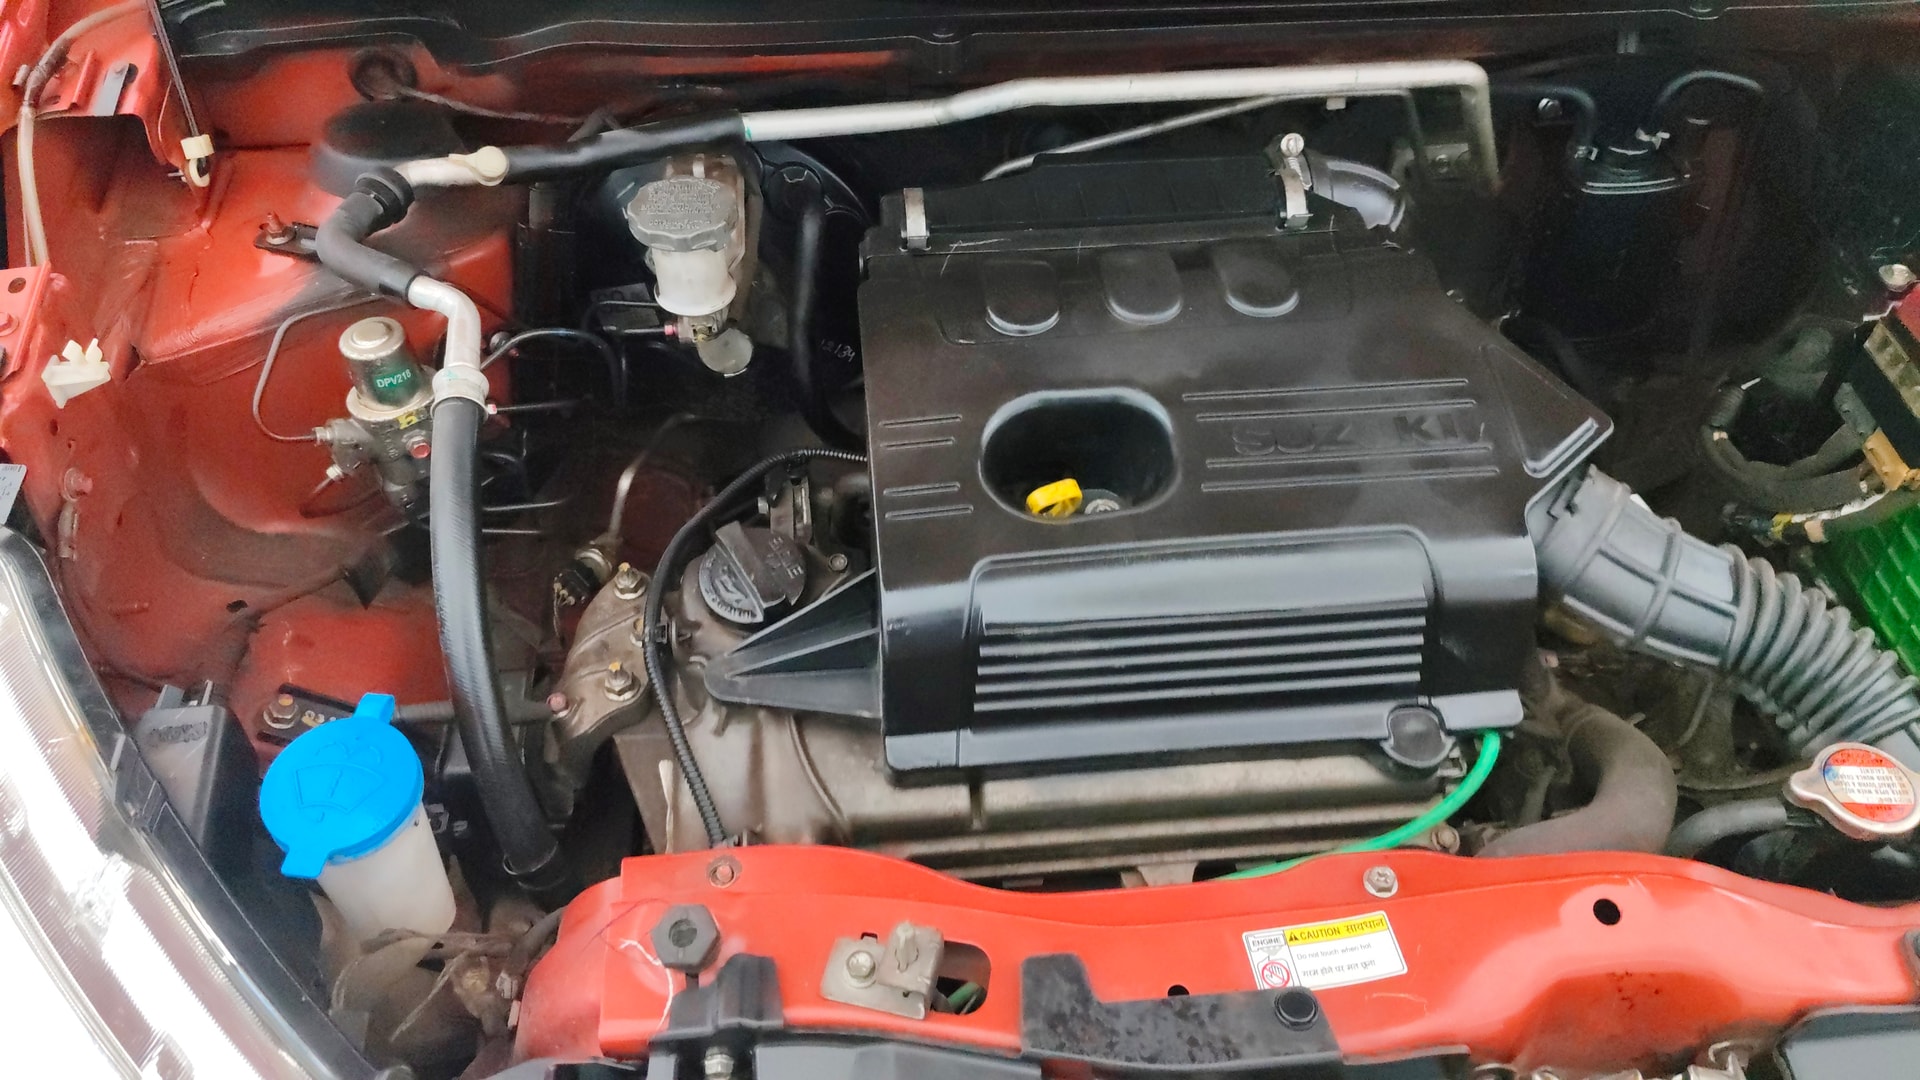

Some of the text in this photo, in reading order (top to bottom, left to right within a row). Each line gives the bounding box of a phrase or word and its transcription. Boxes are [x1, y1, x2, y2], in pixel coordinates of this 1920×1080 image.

[376, 368, 411, 388] DPV218
[1232, 411, 1486, 455] SUZKI
[1252, 936, 1282, 947] ENGINE
[1300, 926, 1341, 941] CAUTION
[1297, 942, 1372, 961] Do not touch when hot
